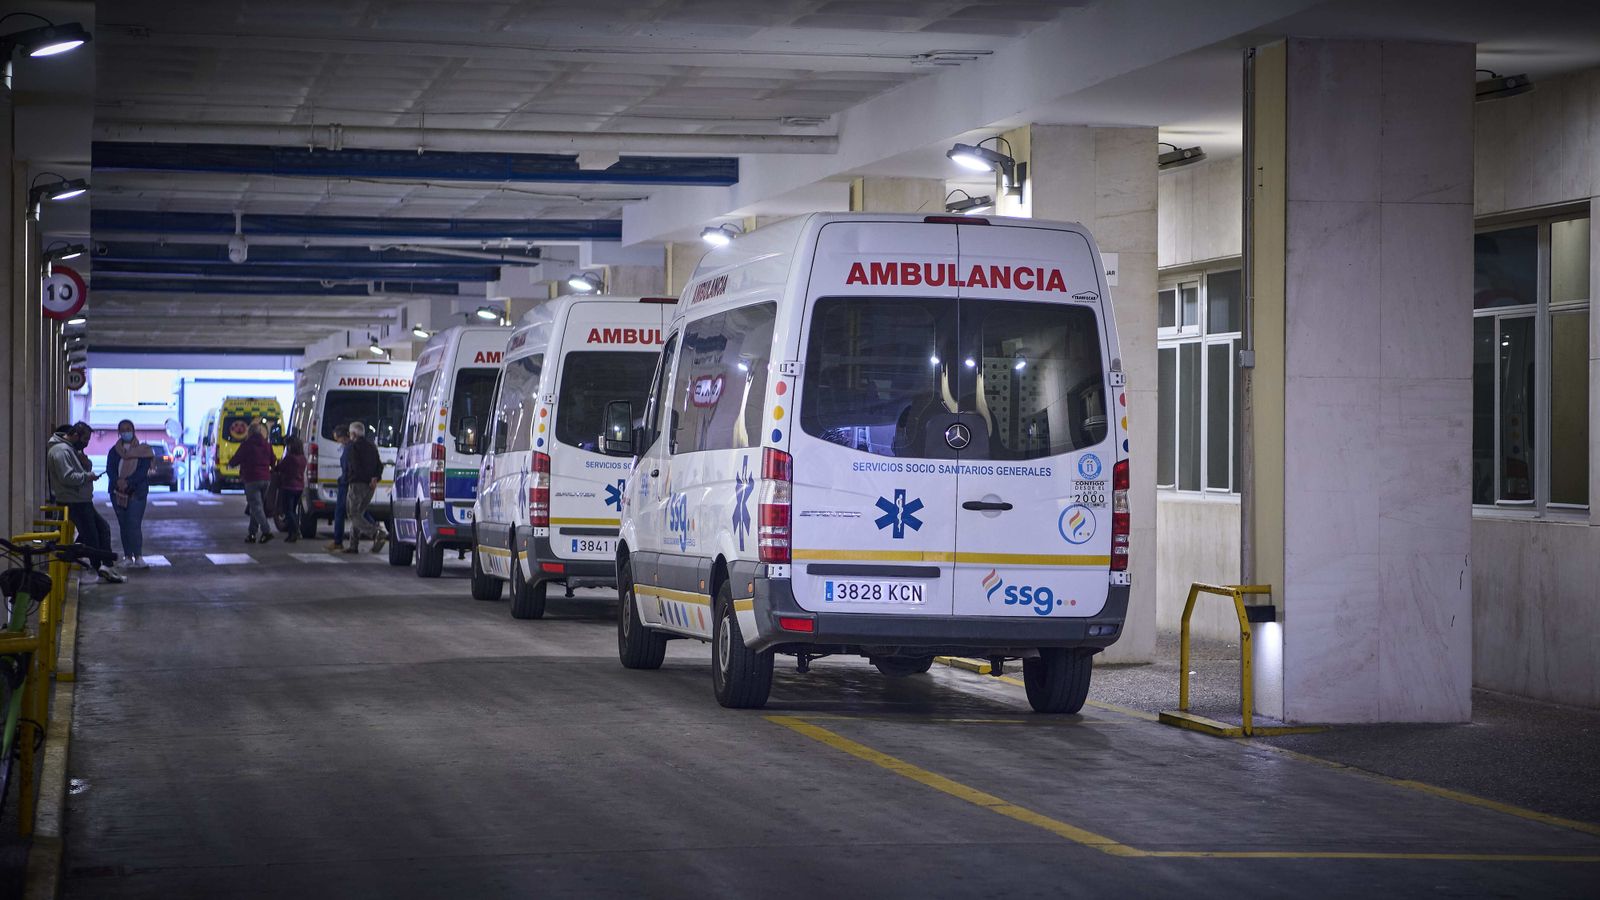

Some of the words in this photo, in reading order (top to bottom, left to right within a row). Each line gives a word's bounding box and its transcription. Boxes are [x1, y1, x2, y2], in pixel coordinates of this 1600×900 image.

[846, 262, 1067, 292] AMBULANCIA
[47, 283, 73, 301] 10
[587, 328, 665, 345] AMBUL
[338, 377, 413, 388] AMBULANCI
[585, 461, 622, 470] SERVICIOS
[853, 462, 903, 472] SERVICIOS
[905, 463, 936, 474] SOCIO
[938, 464, 994, 476] SANITARIOS
[996, 466, 1052, 477] GENERALES
[1074, 494, 1105, 503] 2000
[580, 540, 608, 552] 3841
[837, 583, 882, 600] 3828
[888, 584, 922, 602] KCN
[1004, 585, 1054, 616] ssg
